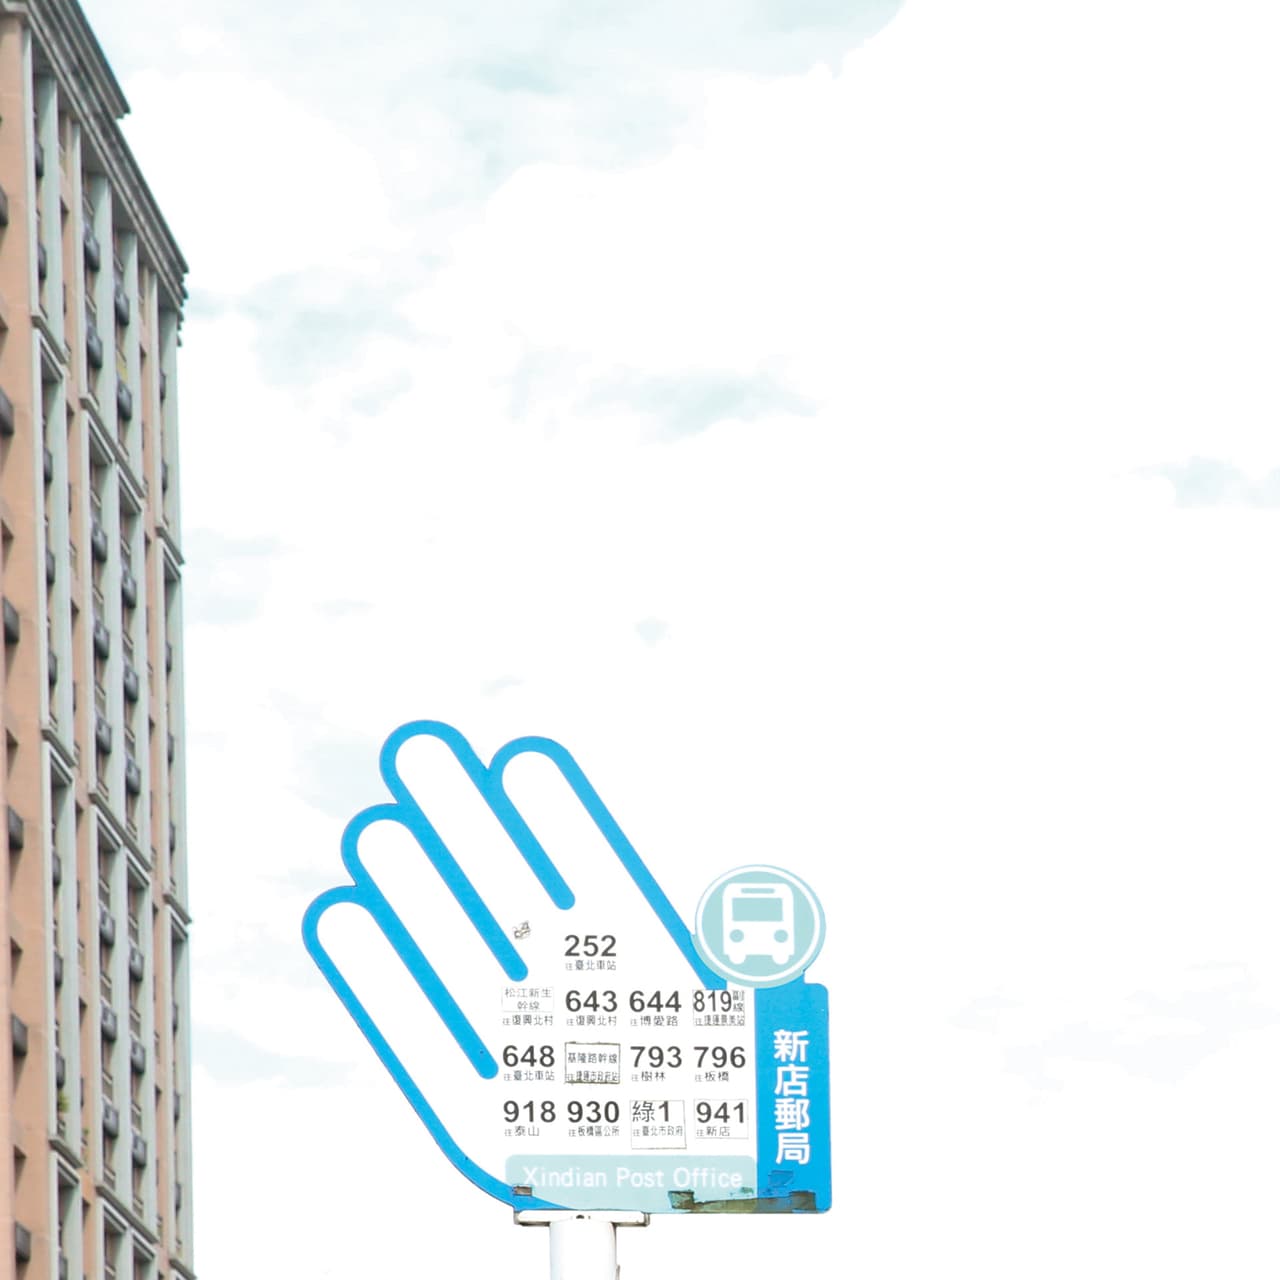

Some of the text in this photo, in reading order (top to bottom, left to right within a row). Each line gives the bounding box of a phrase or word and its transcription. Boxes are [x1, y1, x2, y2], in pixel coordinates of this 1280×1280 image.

[564, 935, 617, 957] 252
[565, 990, 618, 1012] 643
[629, 990, 682, 1012] 644
[693, 990, 732, 1012] 819
[502, 1045, 555, 1067] 648
[630, 1046, 682, 1068] 793
[693, 1046, 746, 1068] 796
[773, 1028, 812, 1165] 新店郵局
[503, 1100, 556, 1123] 918
[567, 1101, 620, 1123] 930
[632, 1100, 669, 1122] 綠1
[696, 1101, 744, 1123] 941
[522, 1166, 743, 1188] Xindian Post Office
